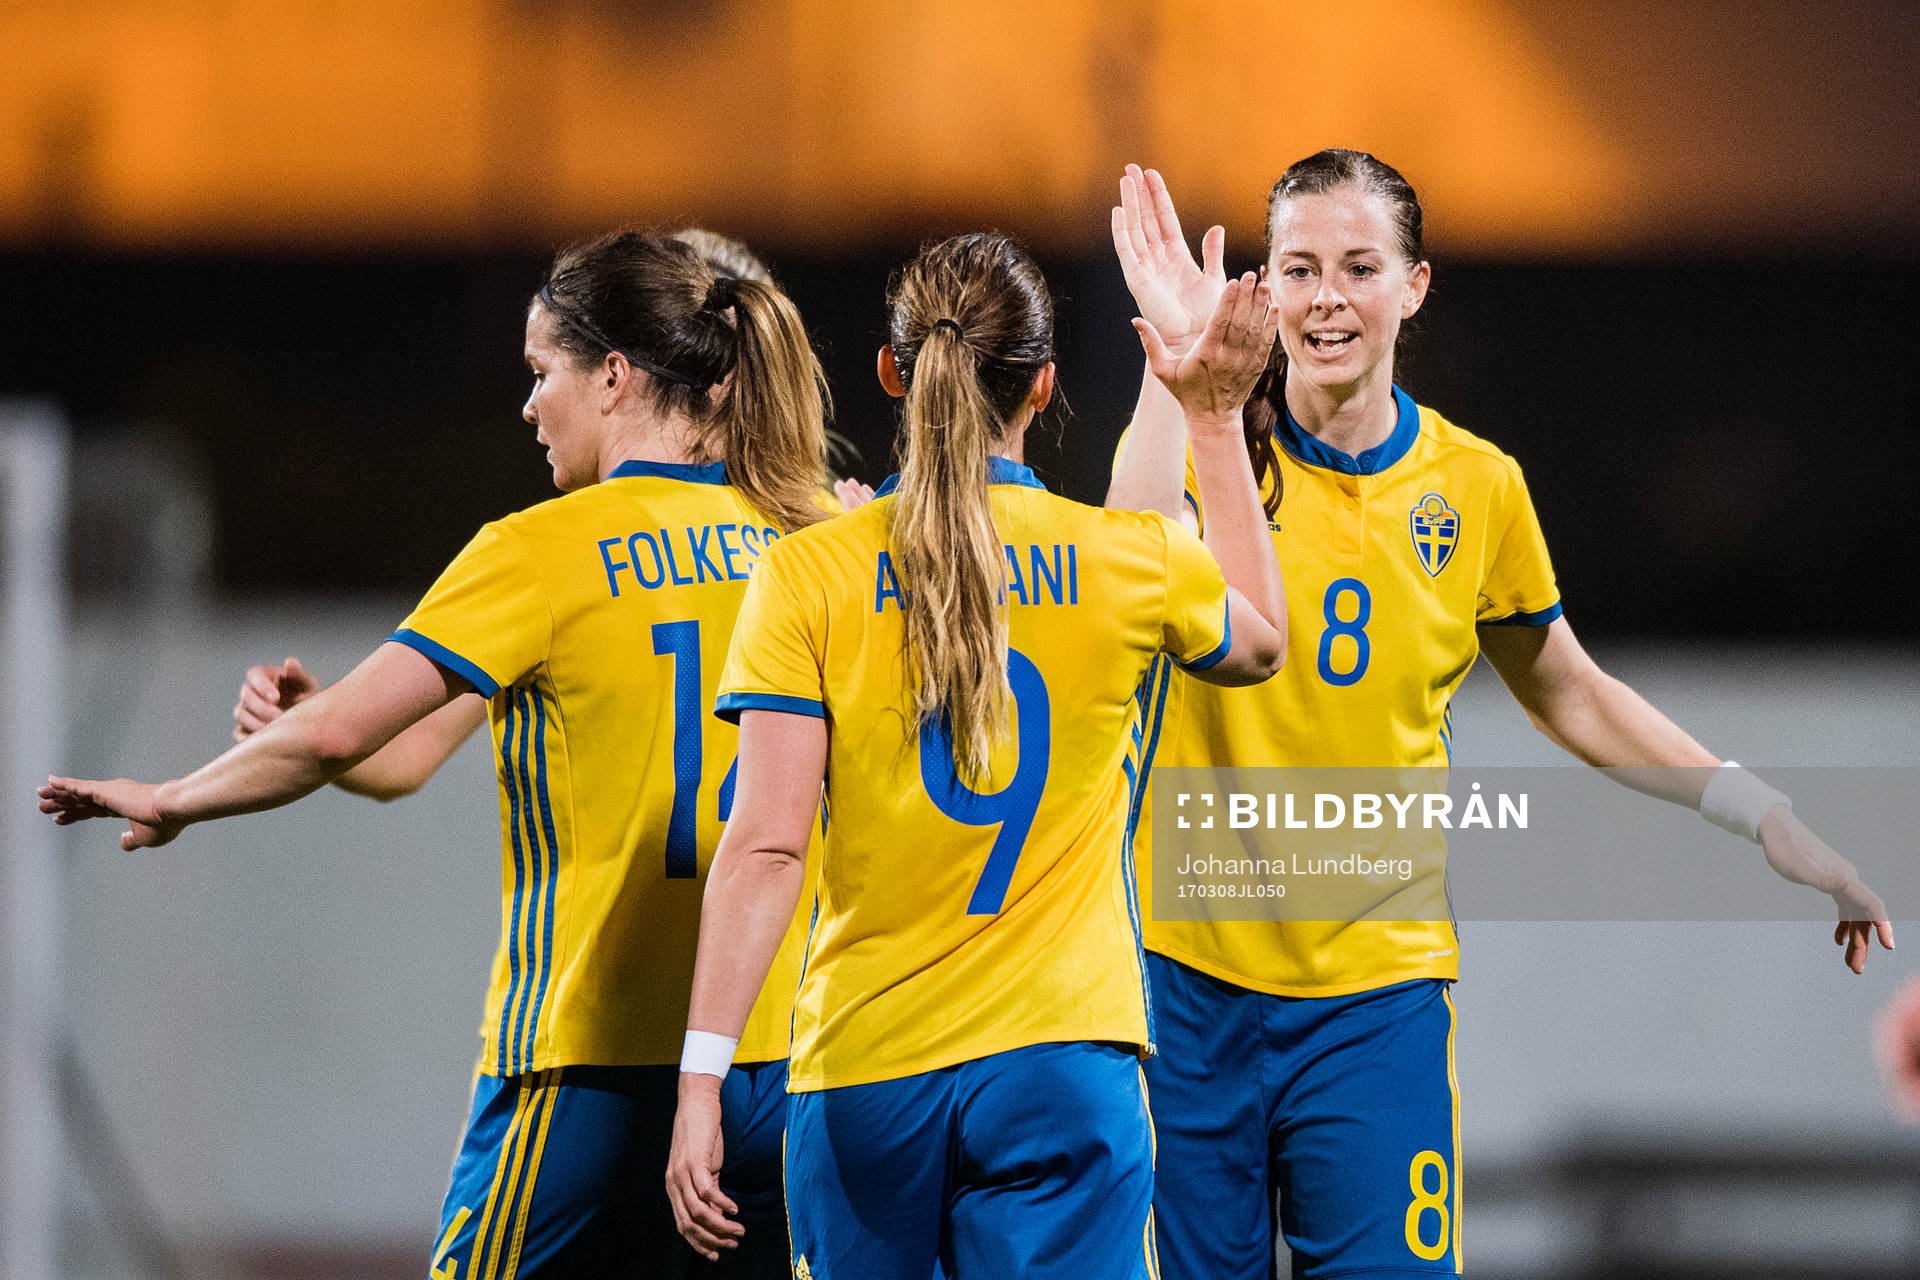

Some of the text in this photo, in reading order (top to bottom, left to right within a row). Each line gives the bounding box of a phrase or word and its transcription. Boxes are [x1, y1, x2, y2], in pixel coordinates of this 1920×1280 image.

[875, 544, 1078, 613] AANI
[1317, 577, 1372, 687] 8
[651, 619, 739, 879] 1
[919, 646, 1051, 916] 9
[1404, 1150, 1450, 1261] 8
